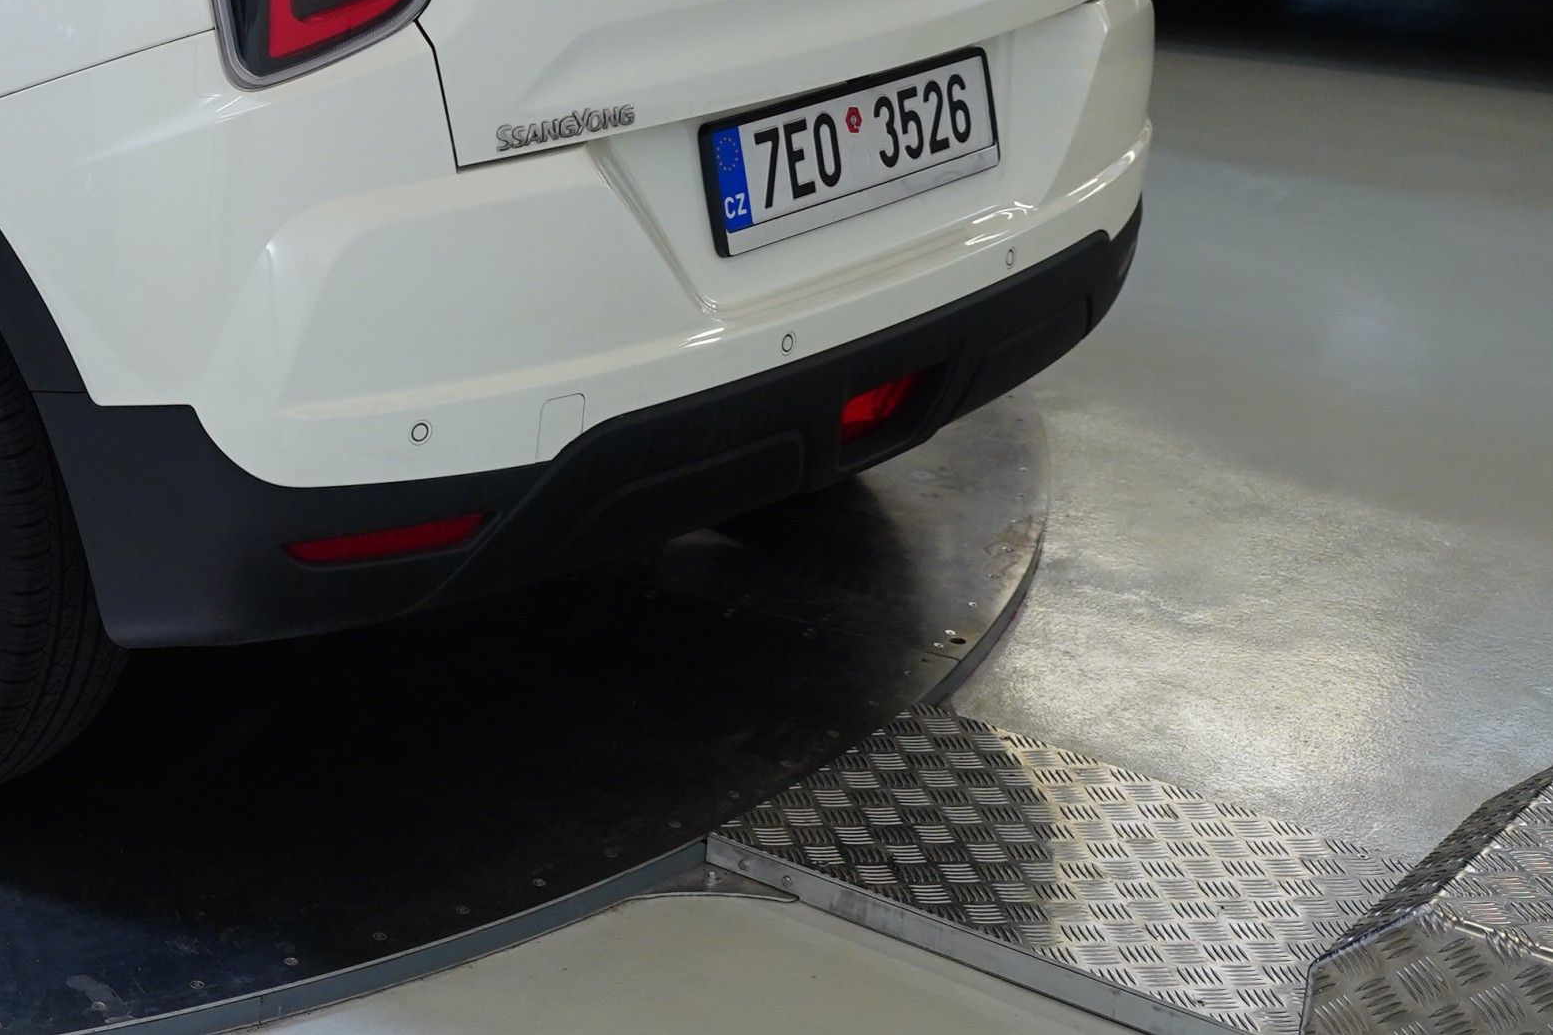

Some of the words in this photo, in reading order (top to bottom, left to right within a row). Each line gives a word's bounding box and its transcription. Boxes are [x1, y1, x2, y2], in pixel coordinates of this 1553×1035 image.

[753, 112, 842, 209] 7E0
[873, 73, 971, 168] 3526
[724, 192, 748, 219] CZ
